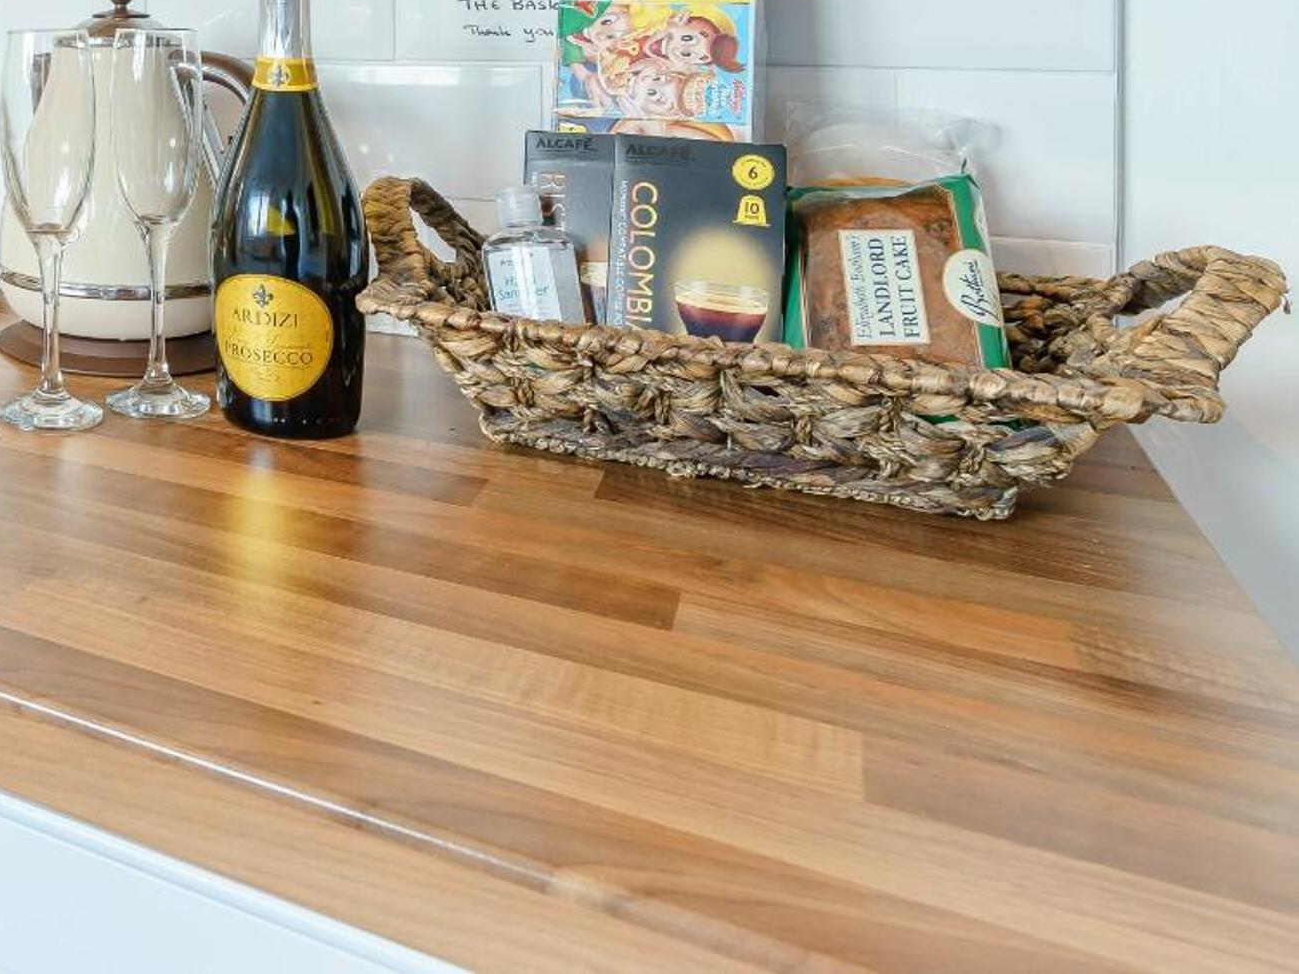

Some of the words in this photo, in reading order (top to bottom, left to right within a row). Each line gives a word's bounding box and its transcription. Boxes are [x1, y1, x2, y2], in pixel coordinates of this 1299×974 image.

[463, 24, 511, 36] Thank
[523, 26, 554, 43] you
[749, 166, 758, 180] 6
[745, 201, 759, 215] 10
[891, 236, 912, 280] CAKE
[867, 237, 895, 337] LANDLORD
[233, 308, 297, 328] ARDIZI
[898, 285, 920, 338] FRUIT
[225, 340, 313, 365] PROSECCO
